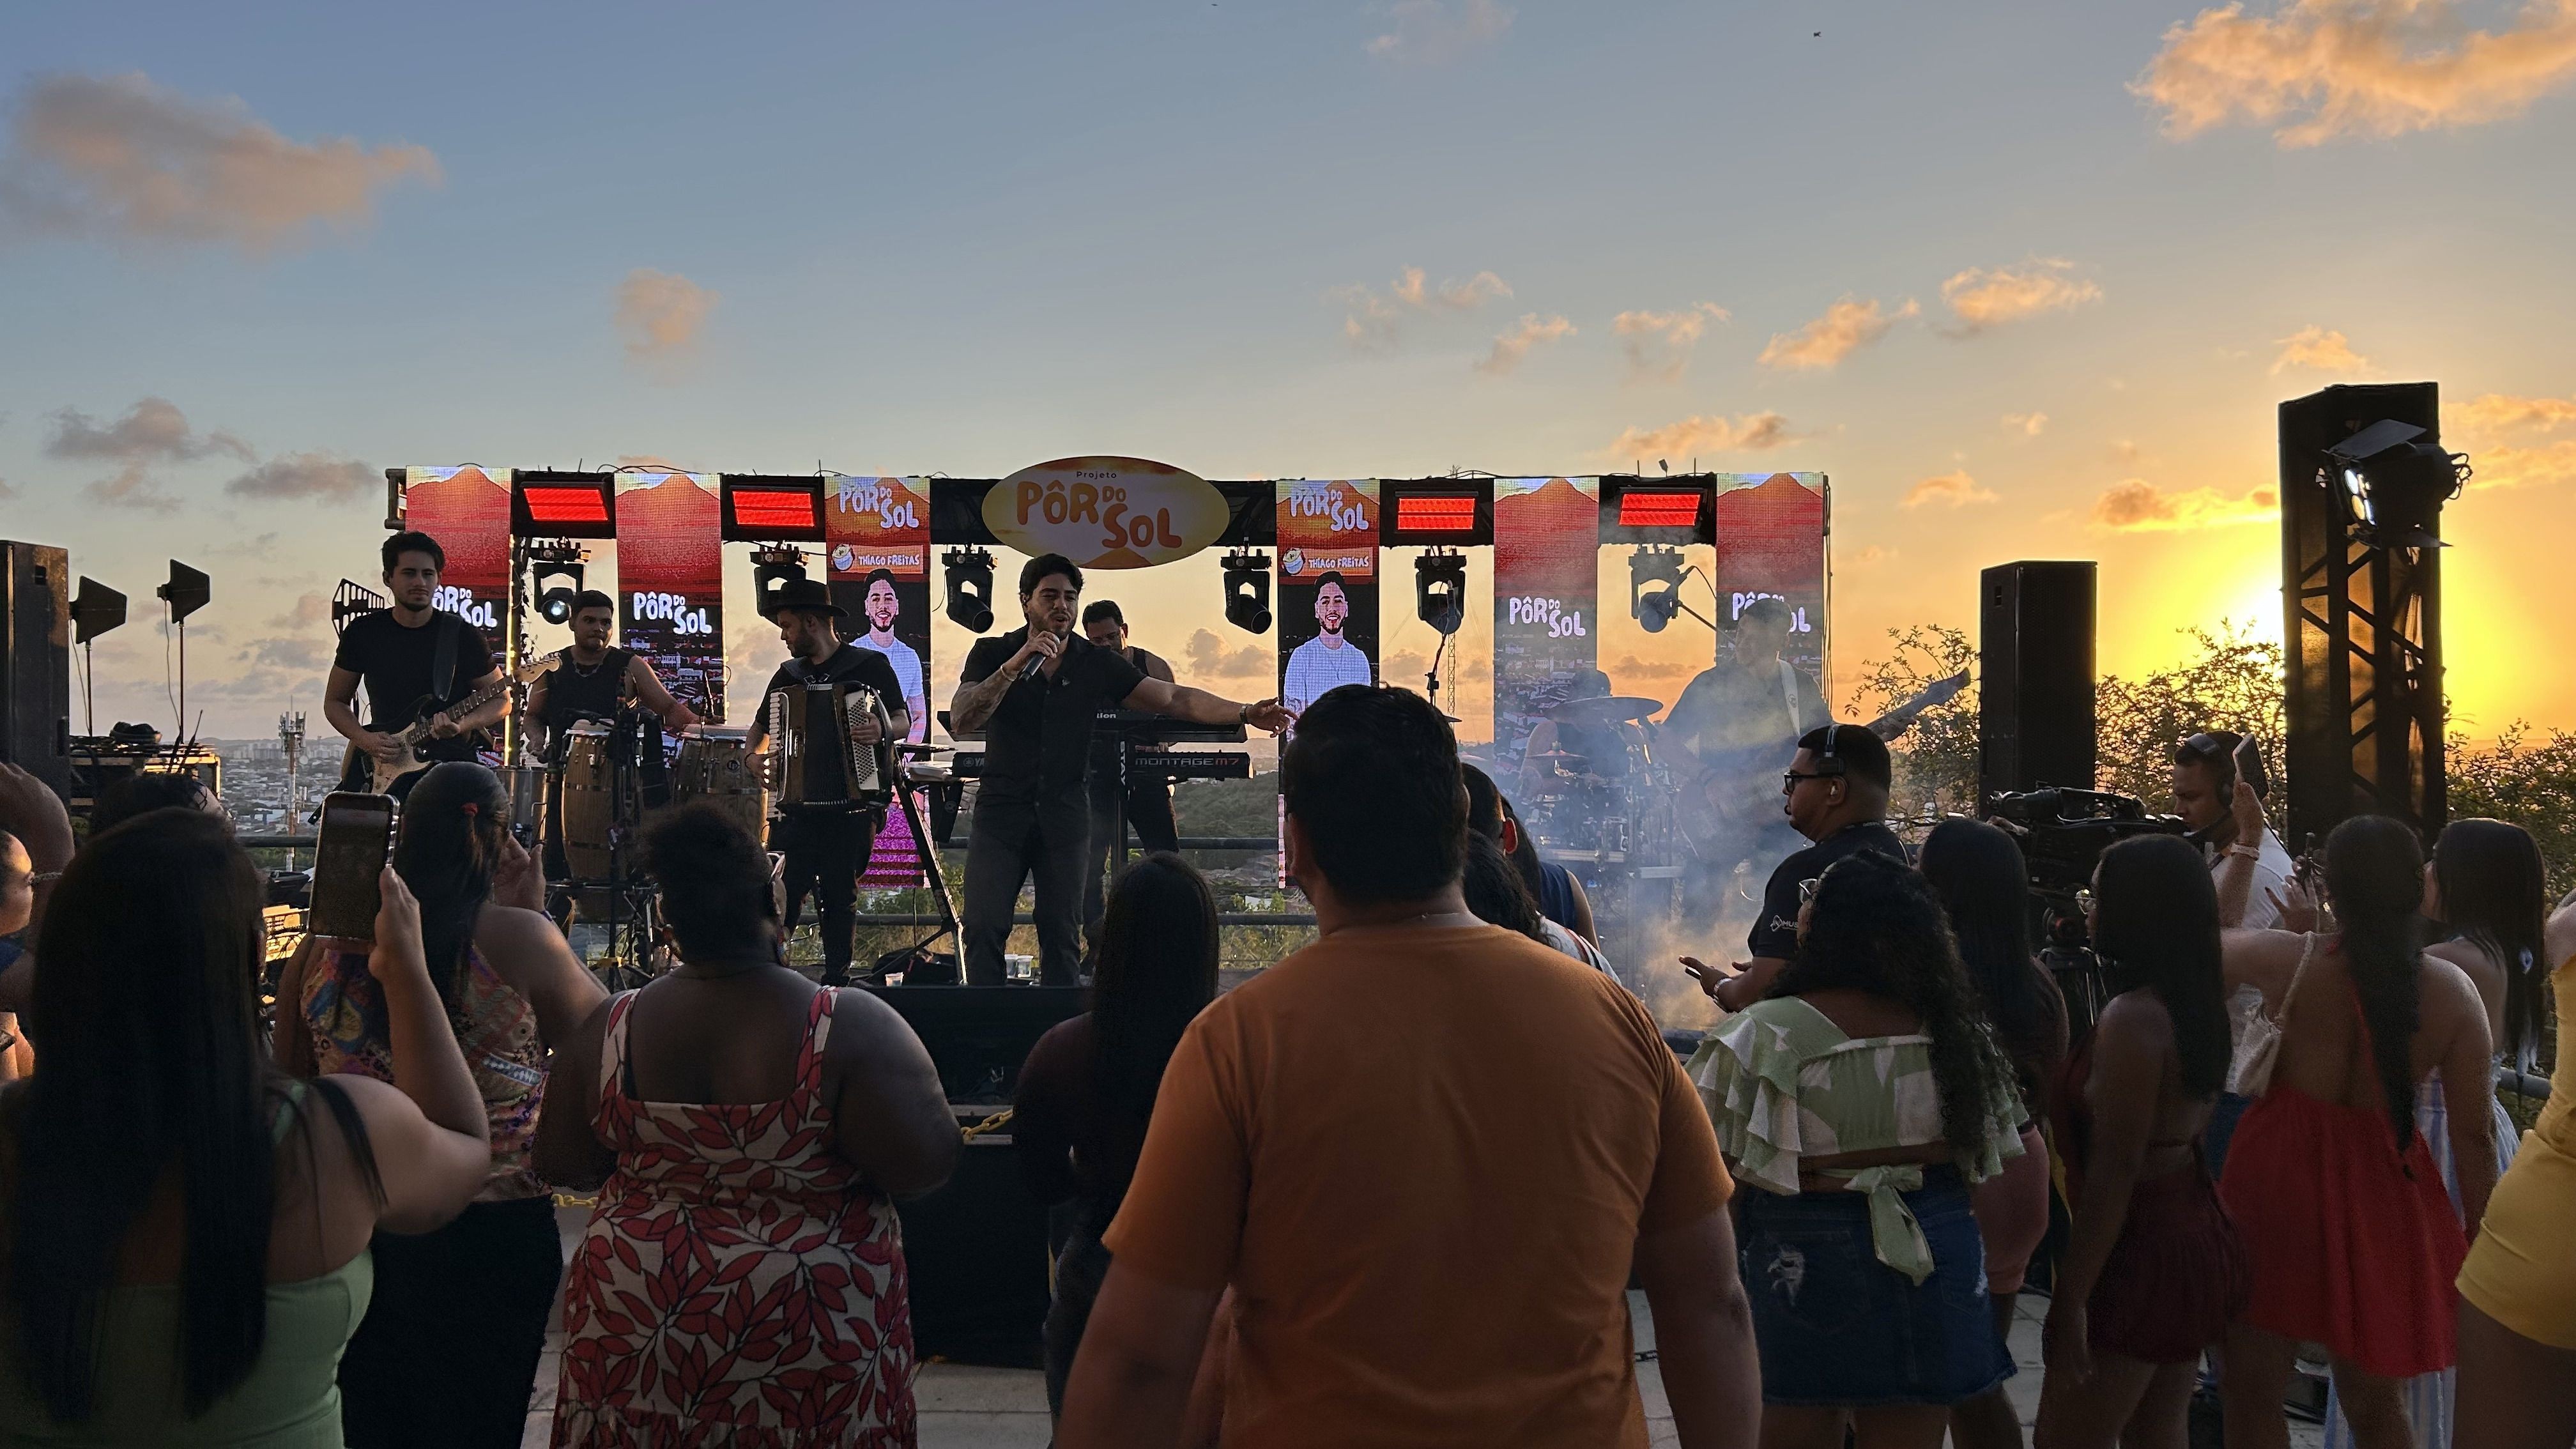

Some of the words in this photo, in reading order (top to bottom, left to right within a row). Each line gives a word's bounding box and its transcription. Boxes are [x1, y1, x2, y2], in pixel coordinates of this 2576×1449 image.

[880, 486, 892, 498] DO
[1017, 480, 1099, 525] PÔR
[1102, 486, 1126, 503] DO
[1331, 489, 1343, 501] DO
[880, 498, 919, 528] SOL
[1101, 503, 1182, 549] SOL
[1331, 500, 1369, 532] SOL
[432, 585, 459, 613] ÔR
[459, 588, 472, 599] DO
[459, 599, 498, 628] SOL
[633, 591, 673, 620] PÔR
[673, 594, 686, 606] DO
[1509, 595, 1547, 625] PÔR
[1548, 599, 1561, 610] DO
[673, 605, 712, 634] SOL
[1548, 609, 1586, 638] SOL
